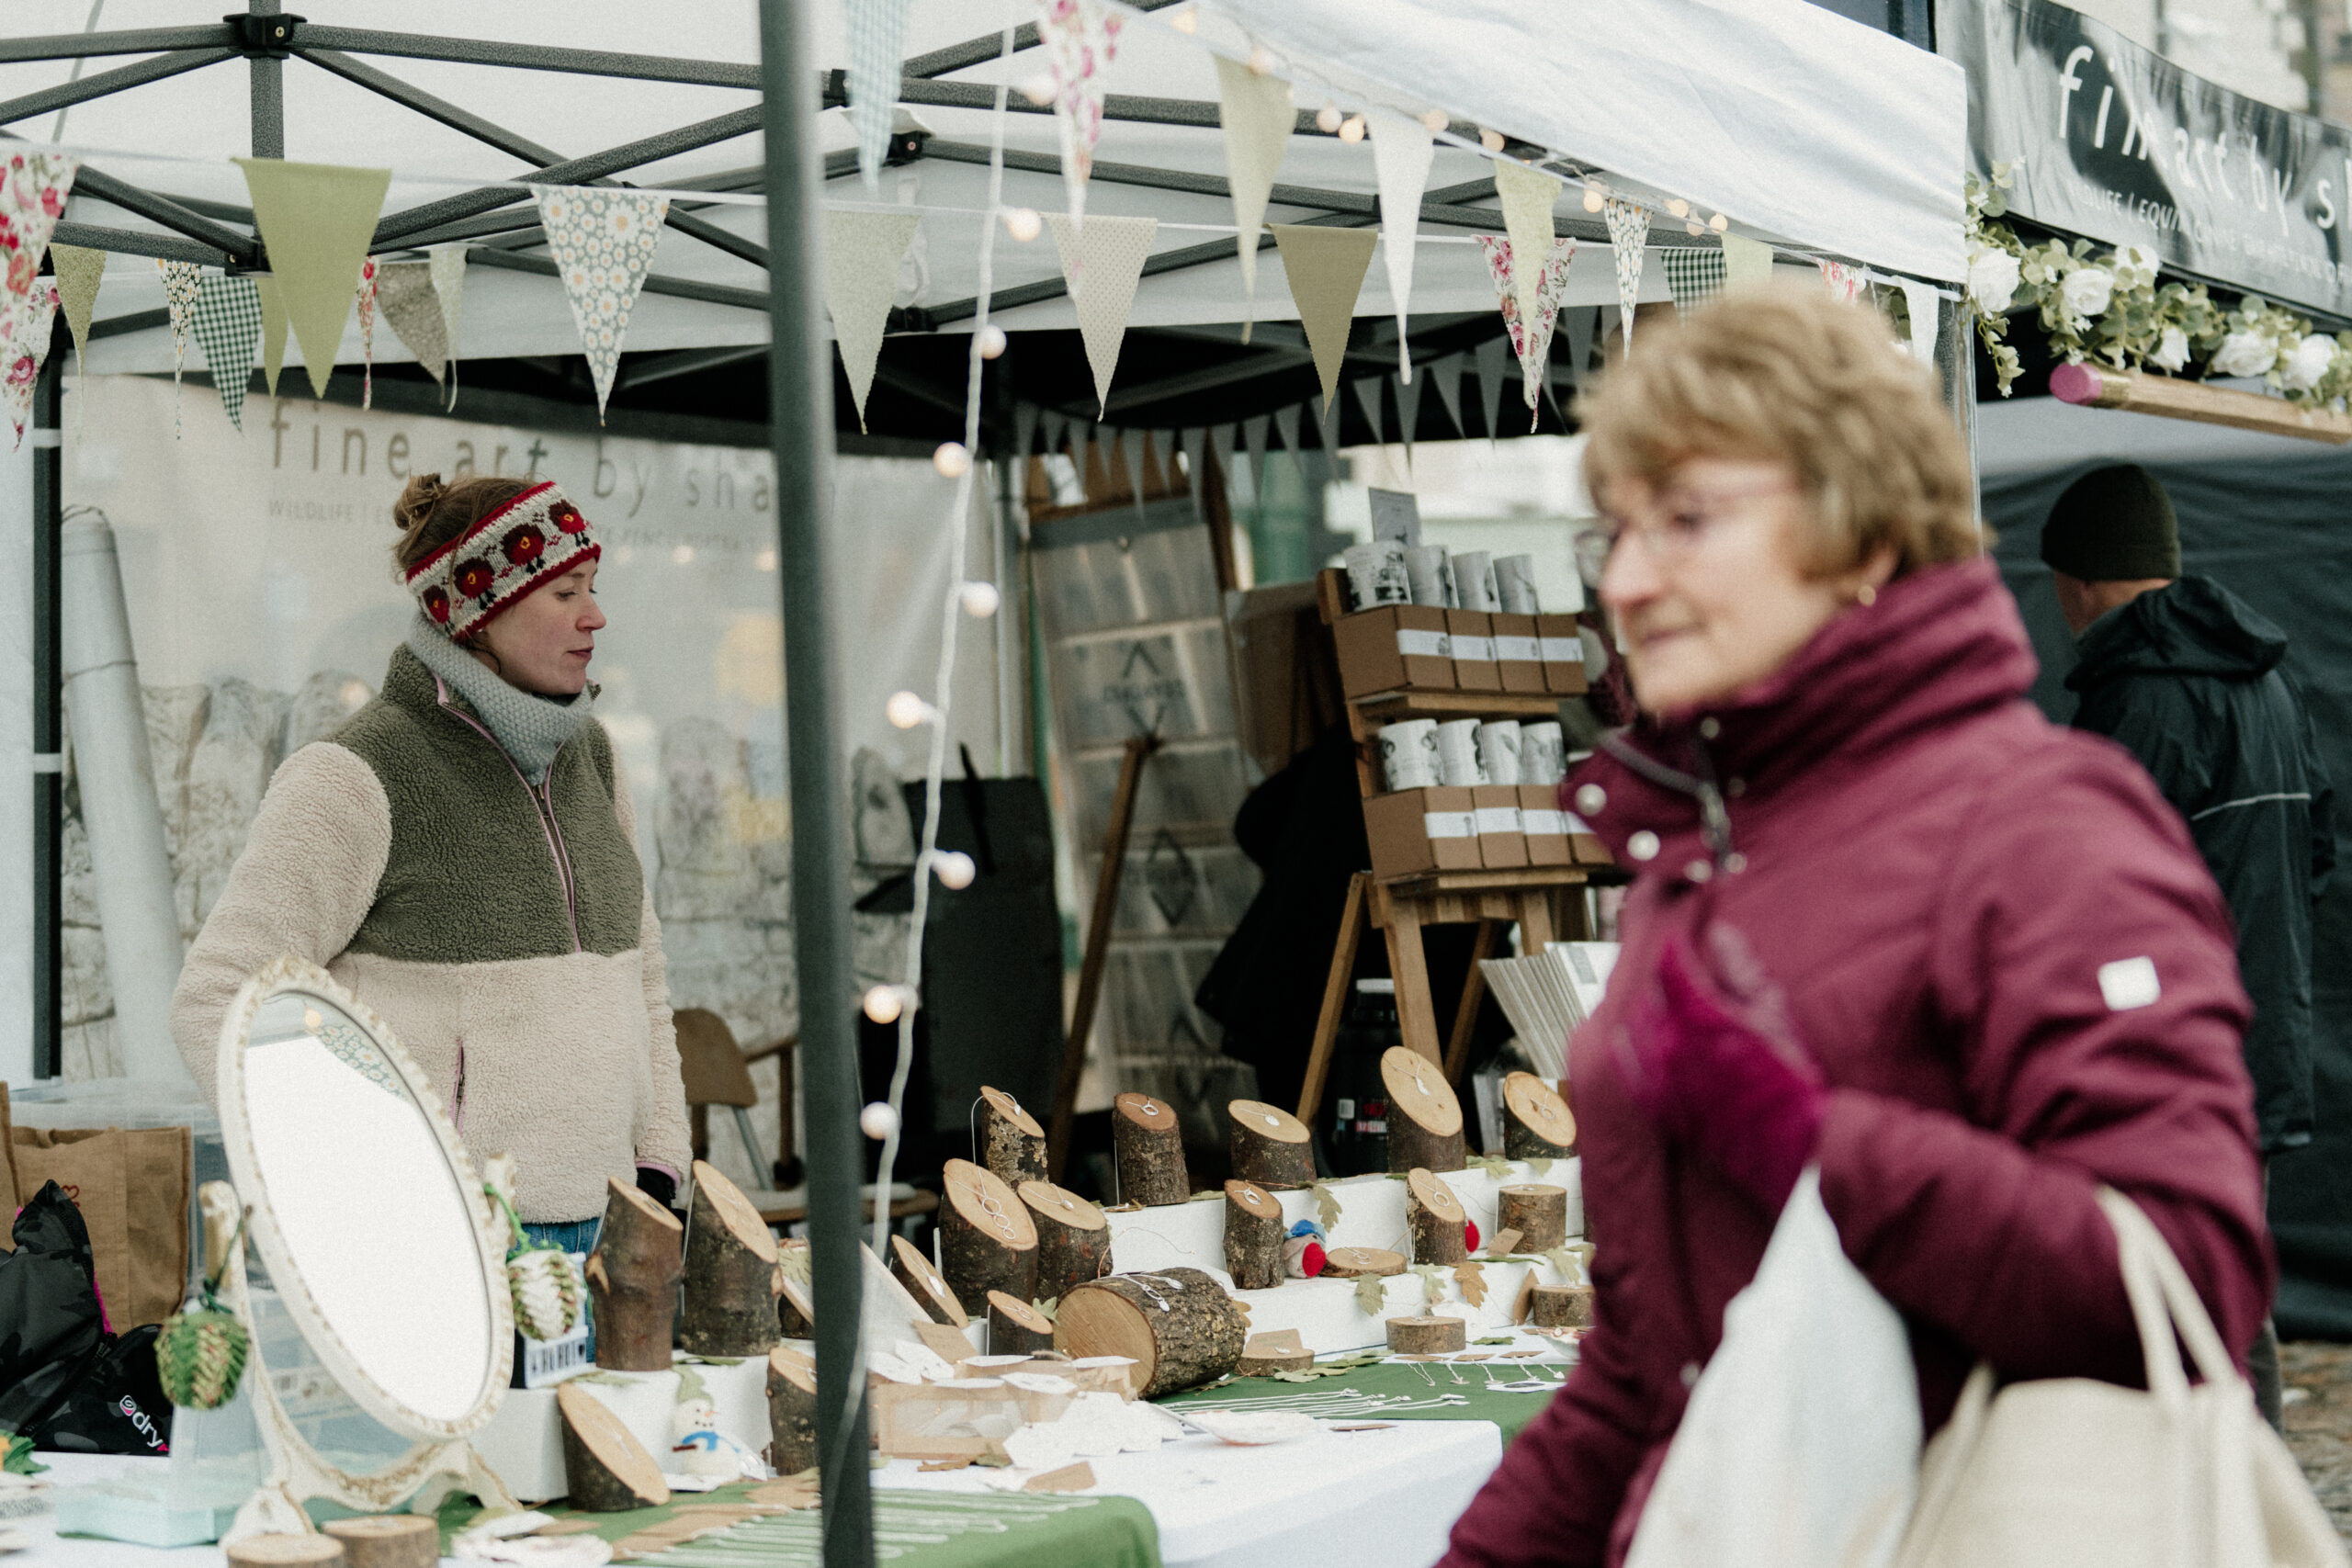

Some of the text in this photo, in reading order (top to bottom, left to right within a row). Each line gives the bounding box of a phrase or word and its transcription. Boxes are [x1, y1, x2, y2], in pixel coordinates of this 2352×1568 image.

[2173, 127, 2234, 201] art
[2250, 134, 2294, 238] by
[269, 399, 410, 480] fine
[456, 439, 549, 480] art
[594, 434, 651, 518] by
